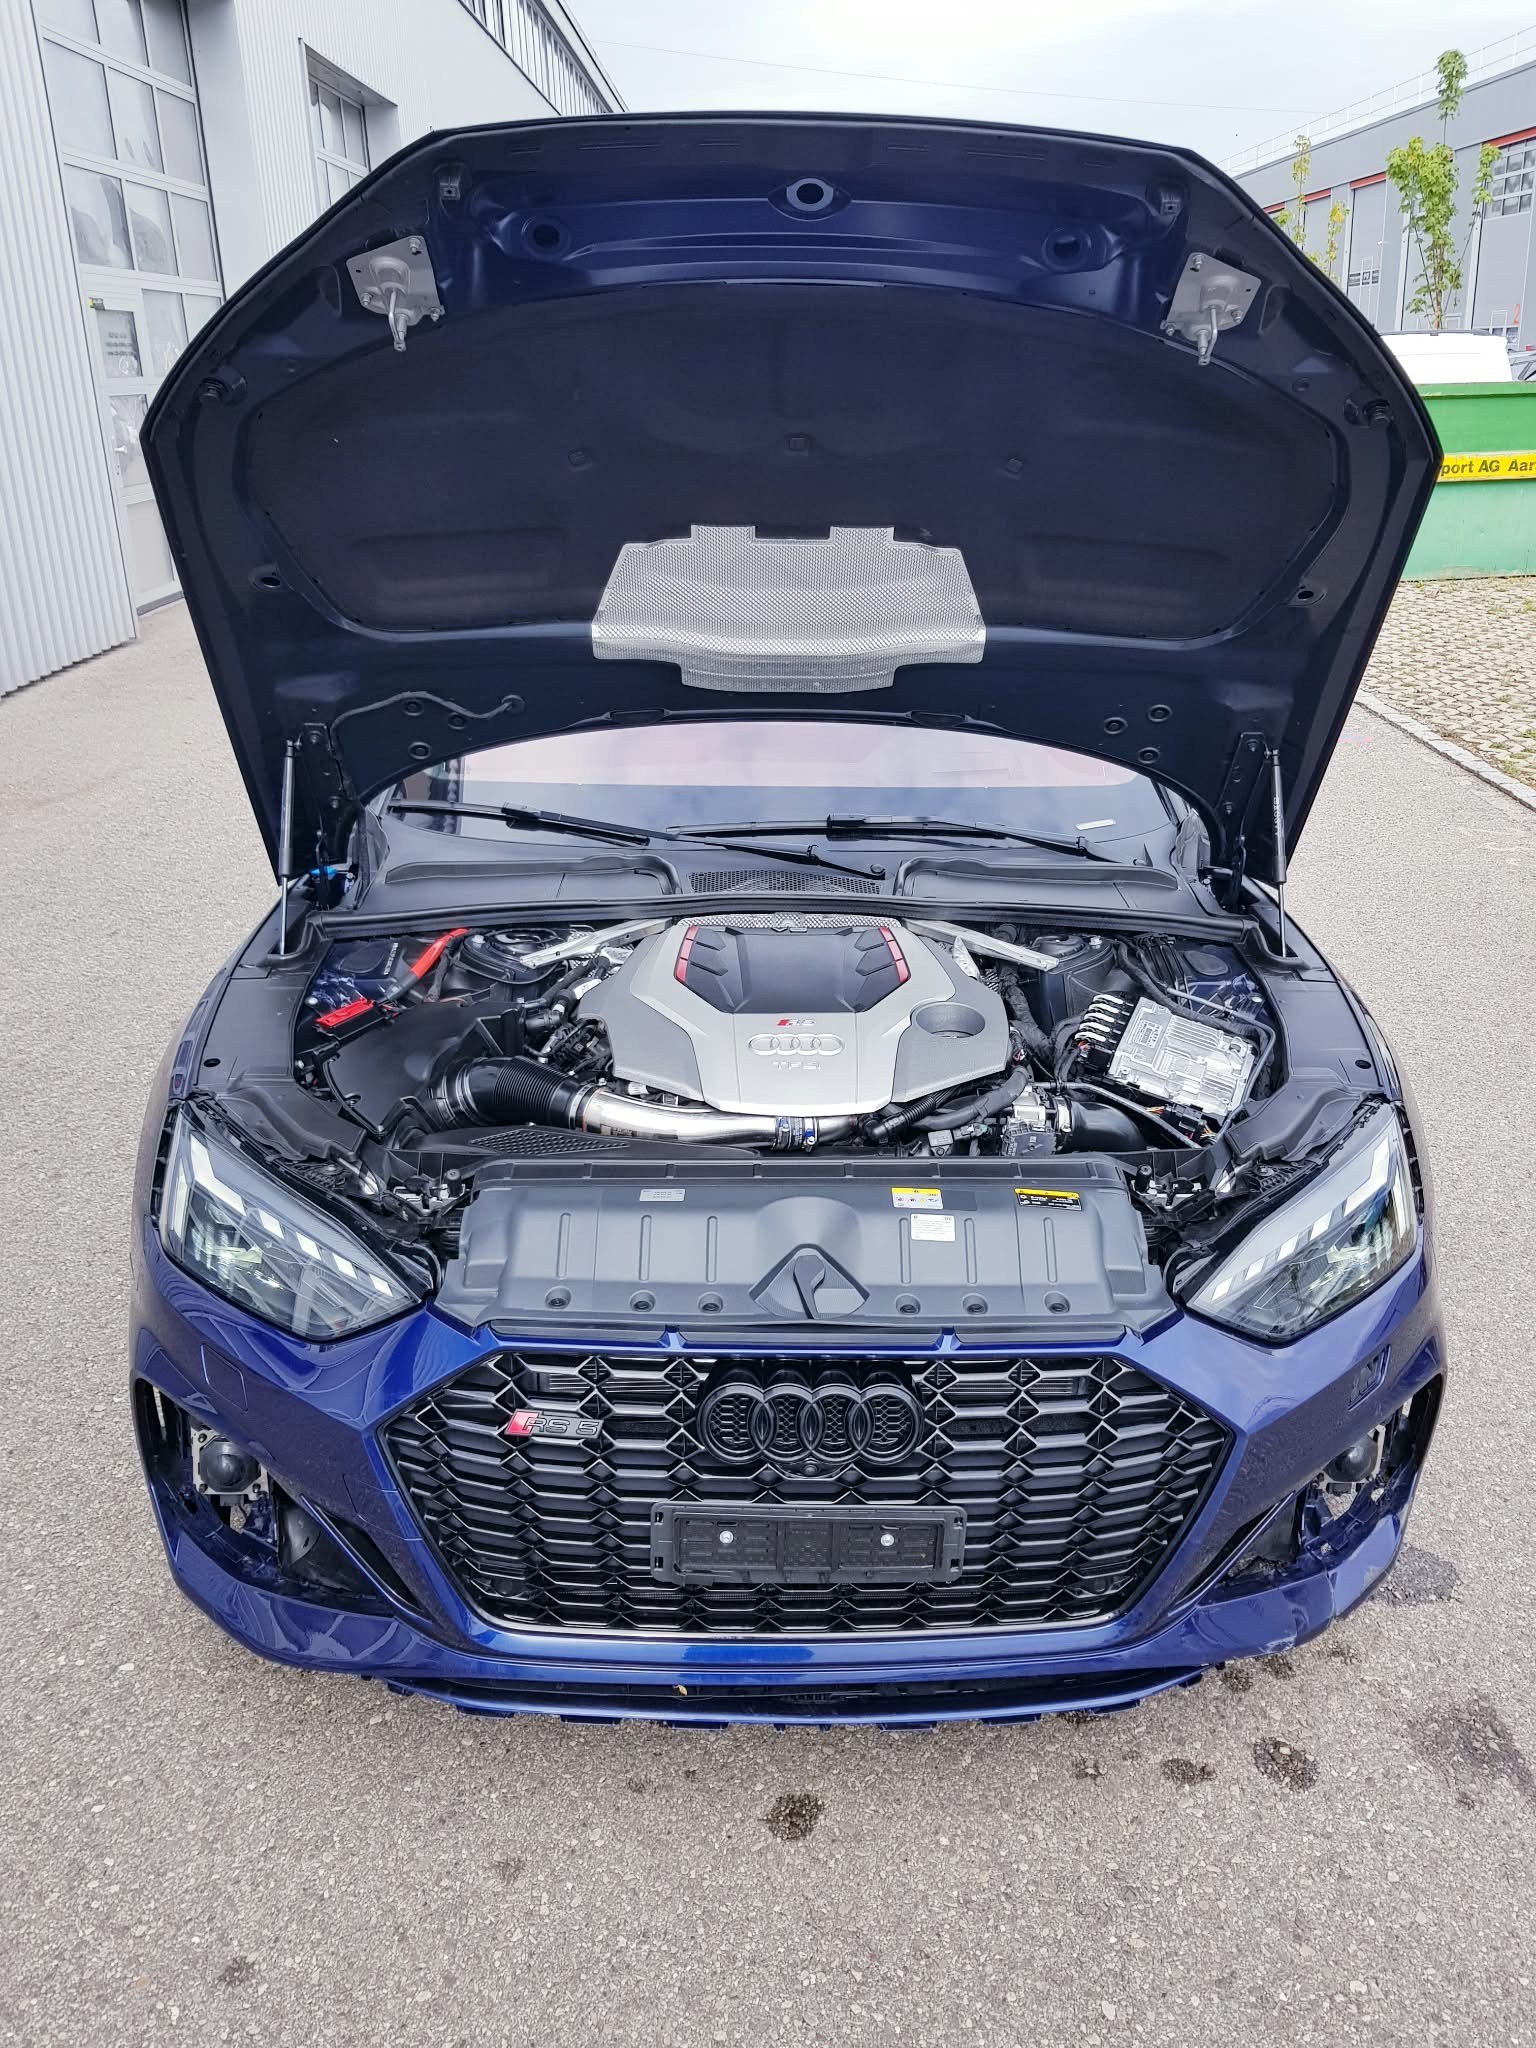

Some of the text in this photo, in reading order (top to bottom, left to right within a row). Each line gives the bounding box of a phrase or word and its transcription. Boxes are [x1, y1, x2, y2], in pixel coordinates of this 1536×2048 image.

[1440, 461, 1474, 476] port
[1478, 459, 1500, 472] AG
[518, 1415, 600, 1436] RS 5
